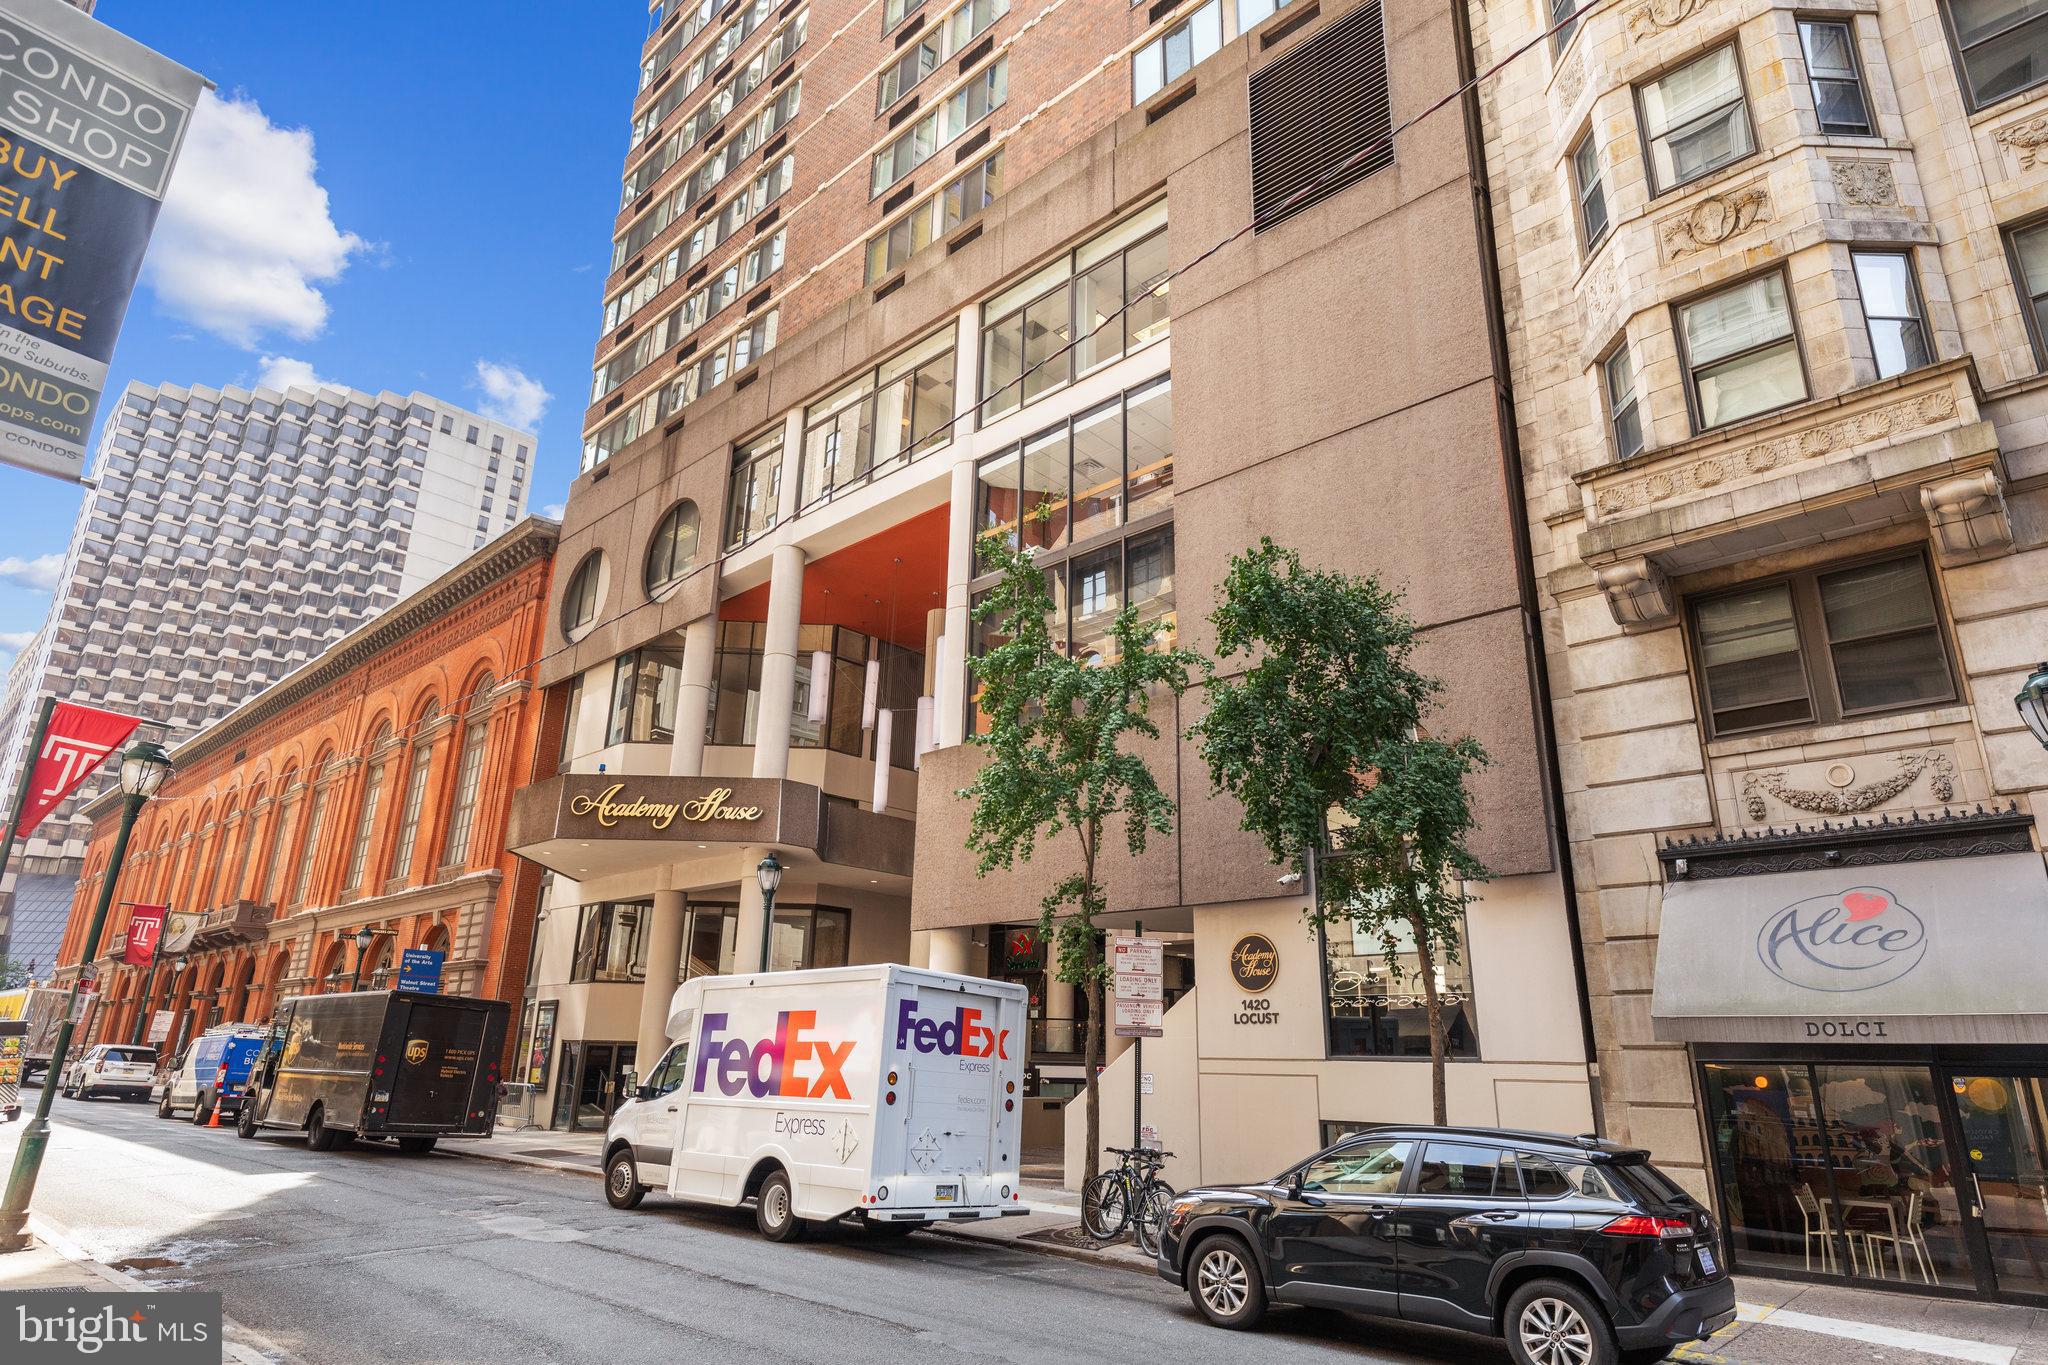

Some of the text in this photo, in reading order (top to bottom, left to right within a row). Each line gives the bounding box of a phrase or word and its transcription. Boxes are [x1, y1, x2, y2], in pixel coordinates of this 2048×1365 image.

[7, 90, 153, 169] SHOP
[0, 185, 66, 240] ELL
[0, 236, 65, 280] NT
[0, 283, 87, 340] AGE
[16, 332, 41, 349] the
[24, 350, 91, 383] Suburbs.
[5, 432, 78, 460] CONDOS
[571, 784, 763, 829] Academy House
[1768, 907, 1910, 970] Alice
[1231, 943, 1275, 967] Academy
[1239, 960, 1275, 978] House
[1234, 1013, 1279, 1024] LOCUST
[1241, 998, 1270, 1011] 1420
[896, 999, 1009, 1060] FedEx
[1805, 1021, 1888, 1037] DOLCI
[407, 1046, 426, 1060] ups
[693, 1010, 857, 1100] FedEx
[960, 1060, 990, 1074] Express
[775, 1112, 826, 1139] Express
